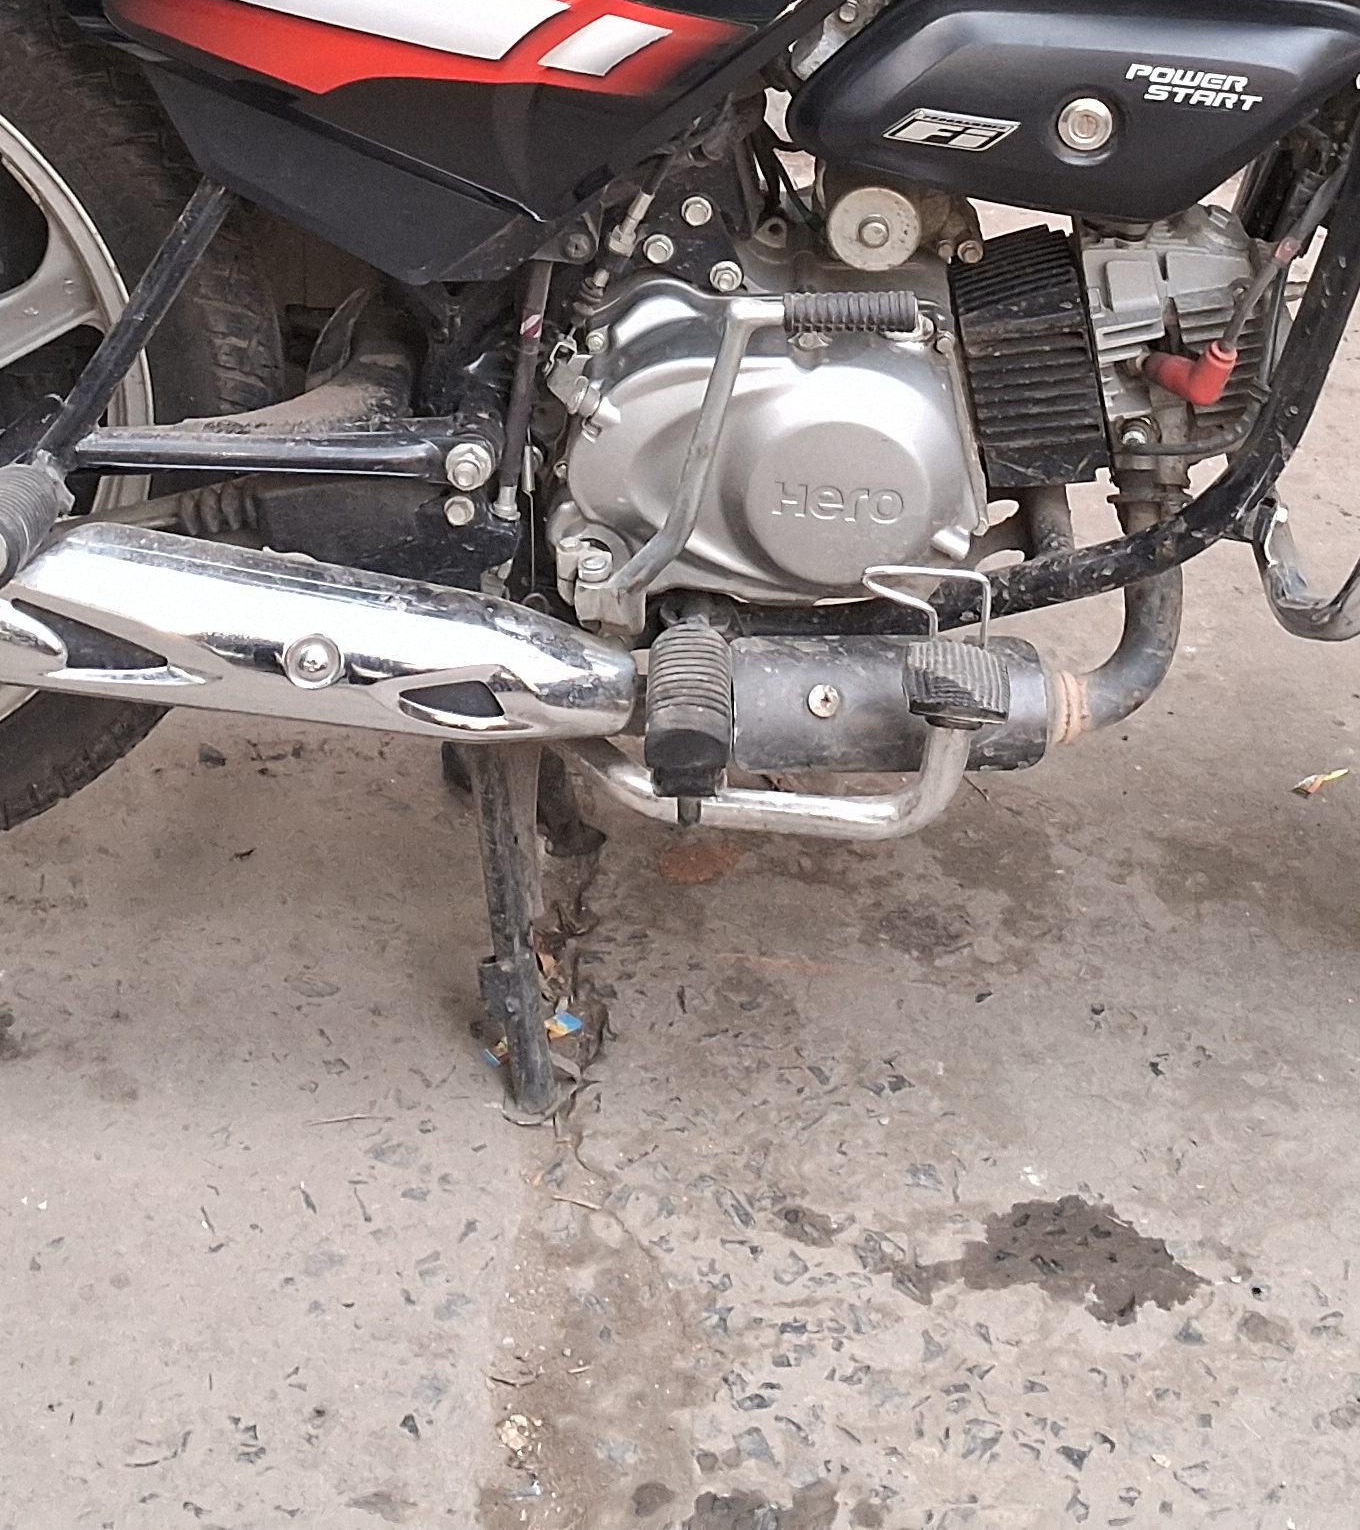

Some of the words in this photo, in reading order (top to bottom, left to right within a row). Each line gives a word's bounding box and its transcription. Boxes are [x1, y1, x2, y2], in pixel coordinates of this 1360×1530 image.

[1125, 63, 1249, 92] POWER
[1143, 84, 1264, 111] START
[771, 480, 904, 524] Hero
